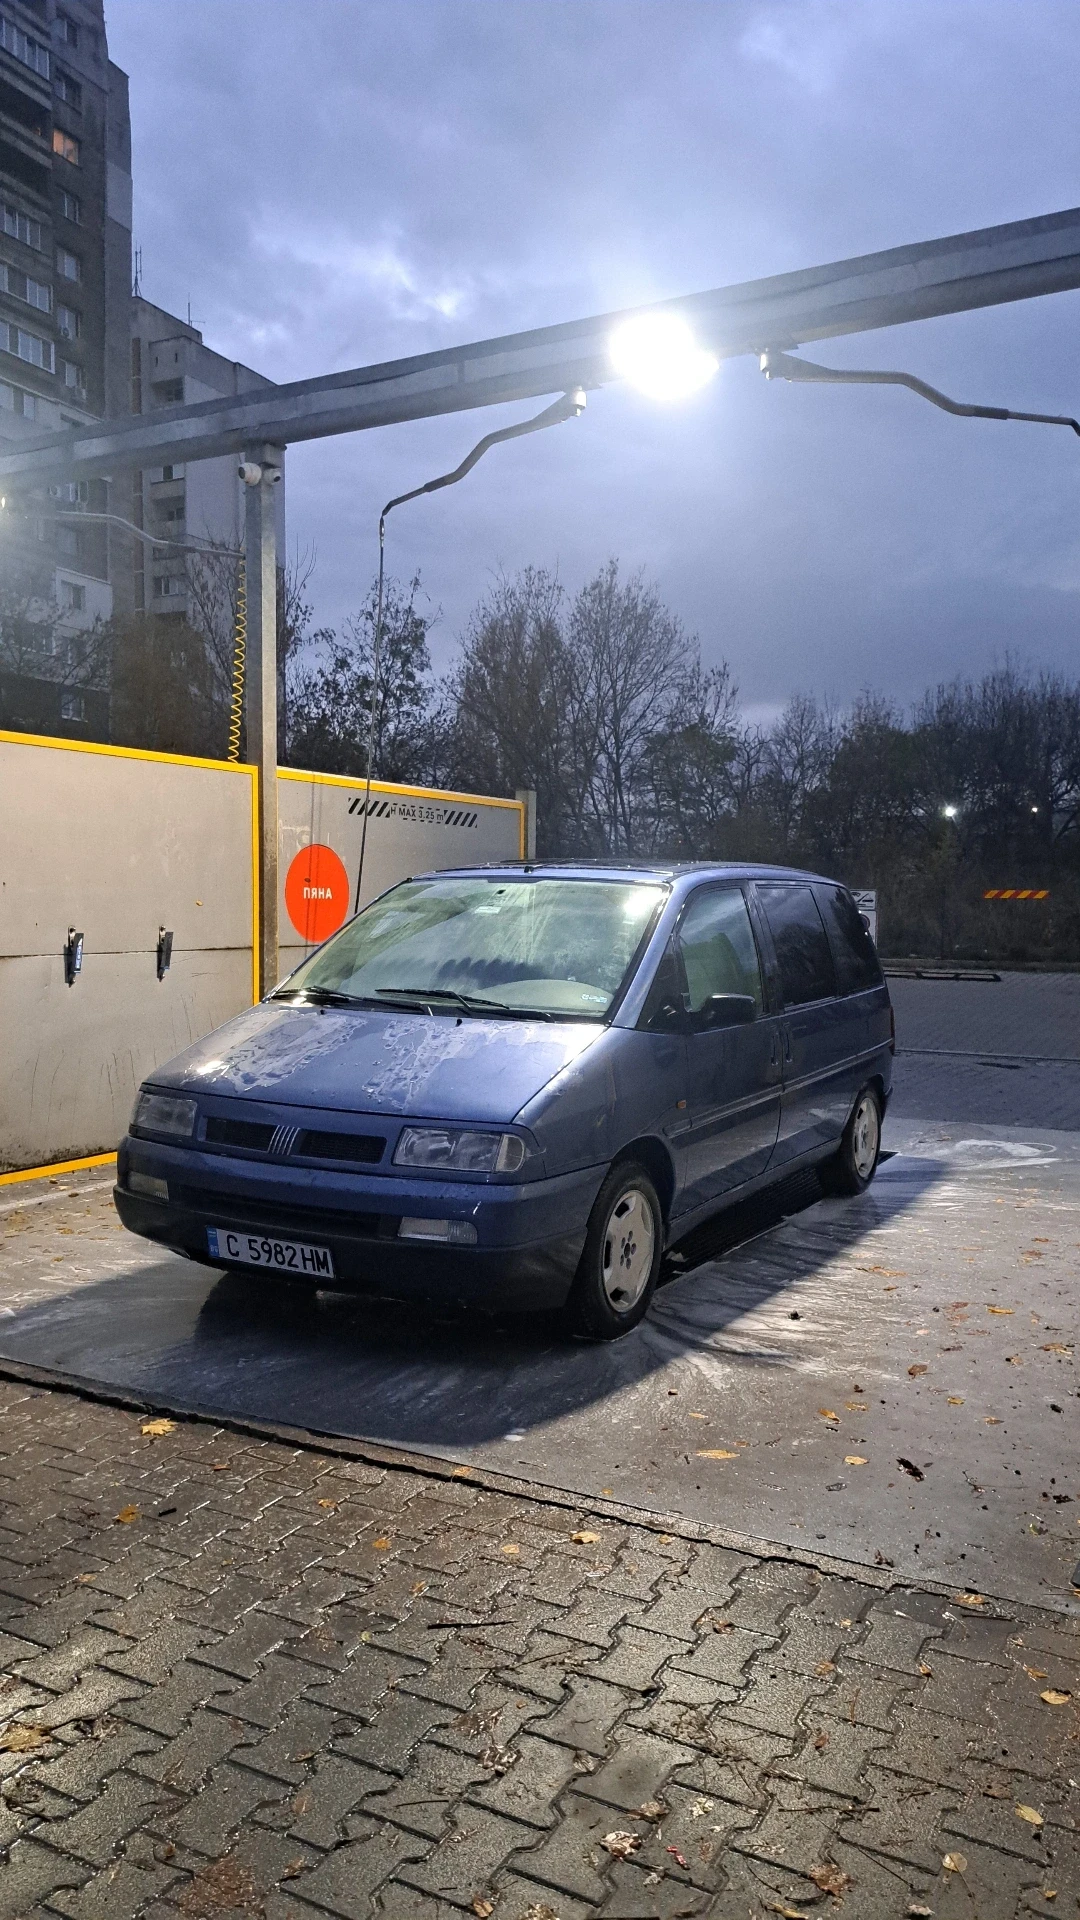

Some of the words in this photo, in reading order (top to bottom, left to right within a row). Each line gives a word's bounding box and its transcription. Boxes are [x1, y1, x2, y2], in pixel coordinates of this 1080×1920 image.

[391, 806, 396, 815] H
[399, 807, 416, 818] MAX
[418, 810, 434, 820] 3.25
[437, 813, 443, 821] m
[303, 886, 333, 900] ПЯНА
[226, 1234, 240, 1257] C
